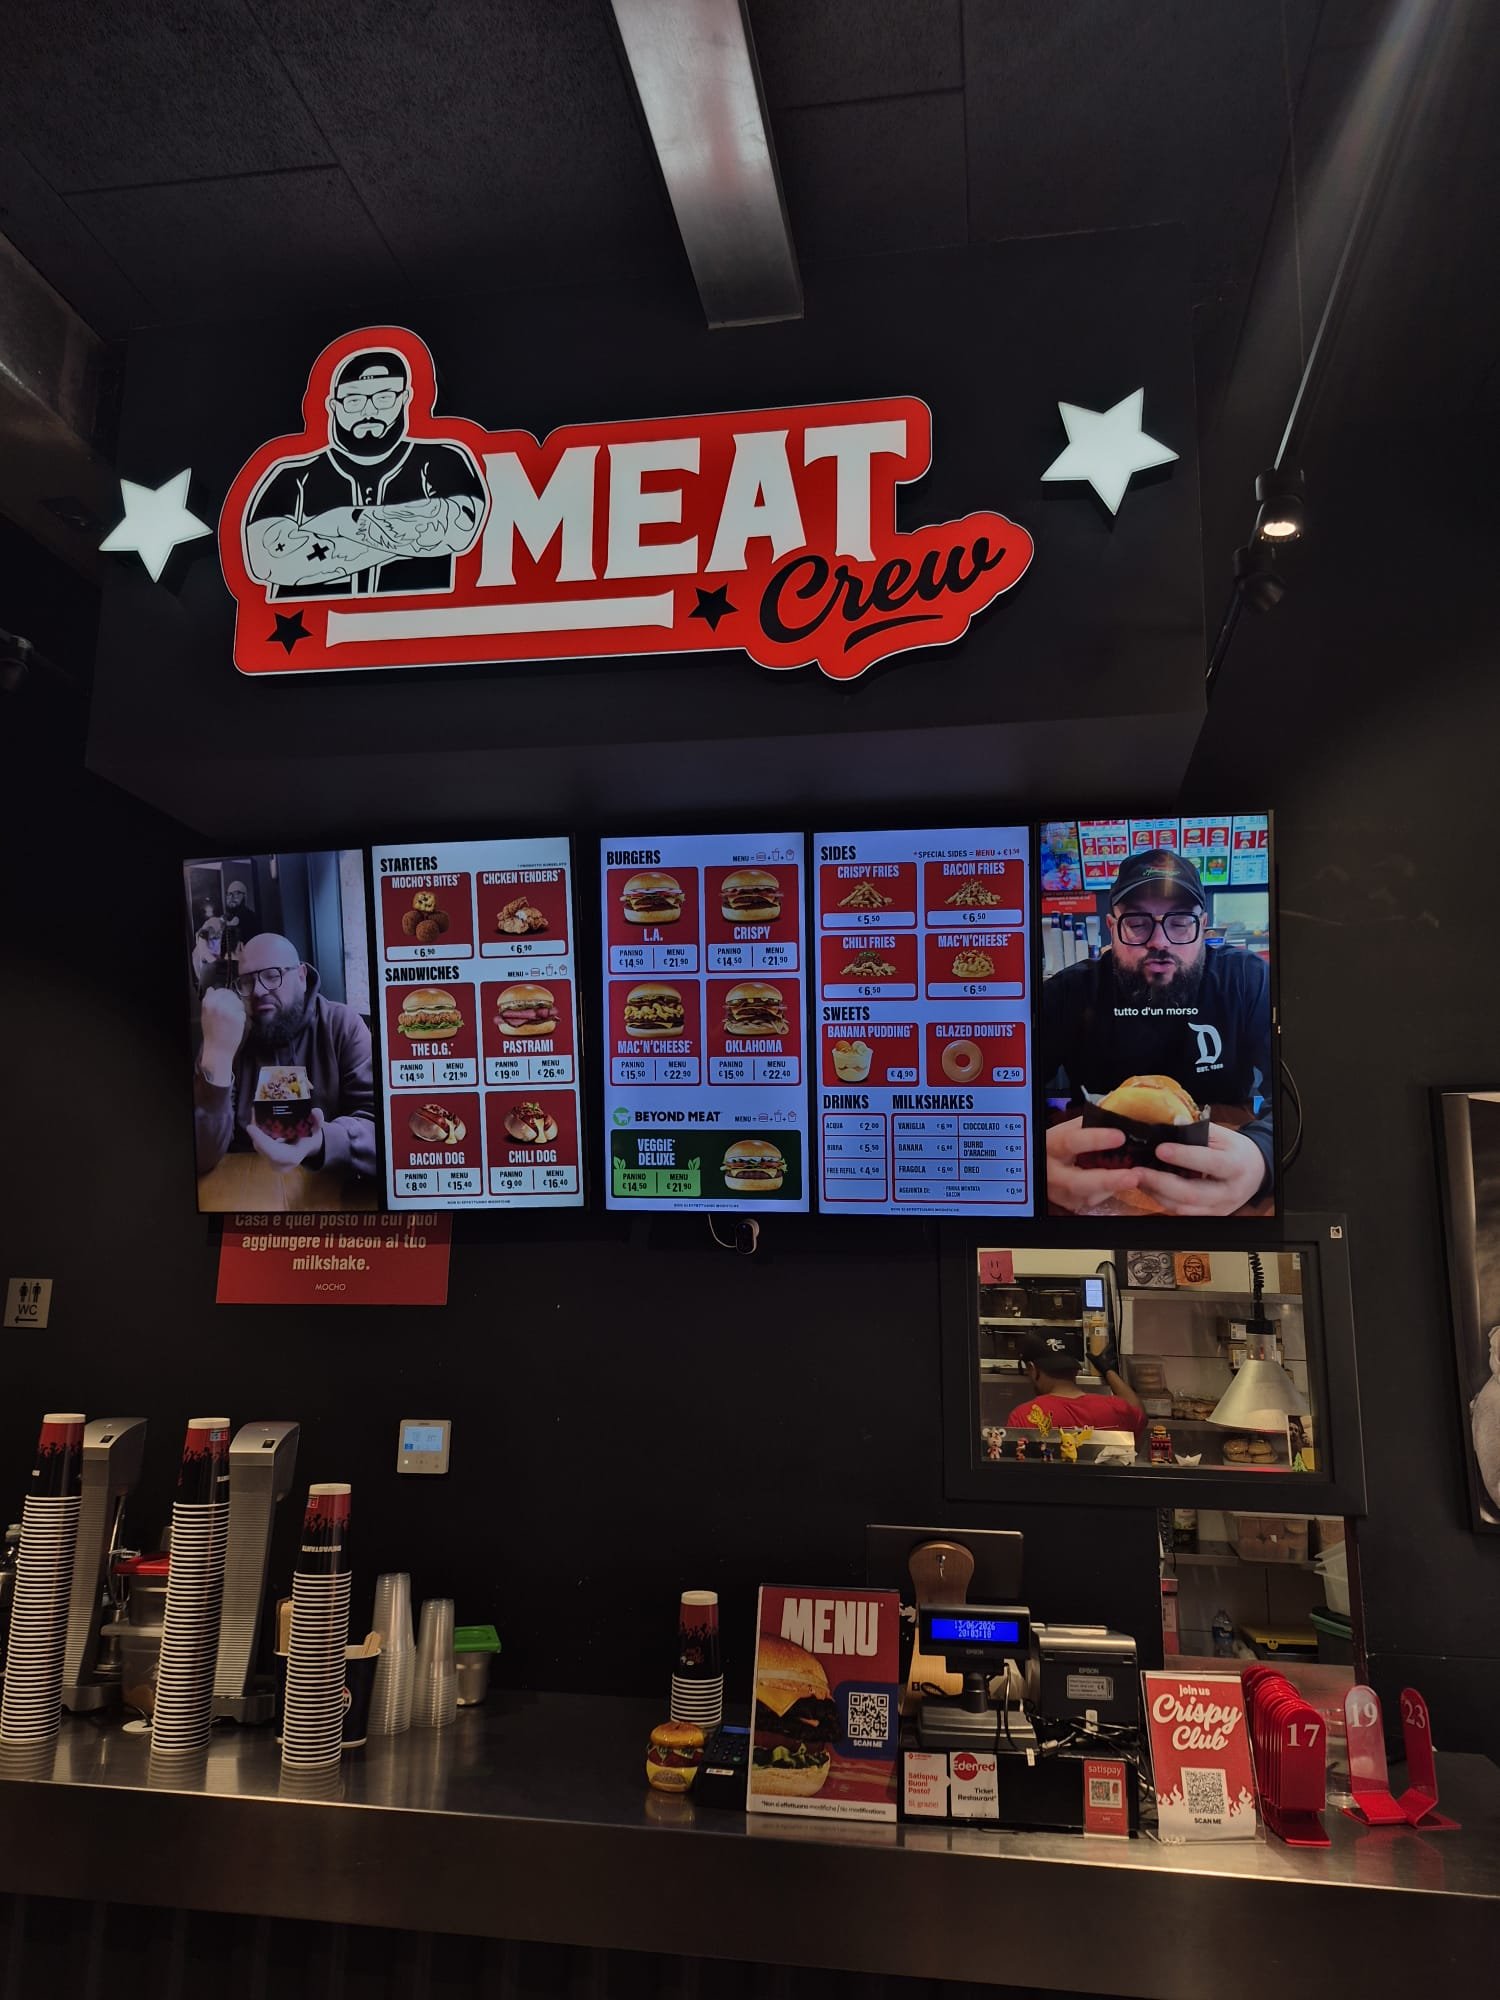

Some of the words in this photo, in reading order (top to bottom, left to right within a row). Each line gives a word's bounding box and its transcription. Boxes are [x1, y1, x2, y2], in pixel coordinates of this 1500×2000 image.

[476, 420, 906, 587] MEAT
[759, 536, 1006, 643] Crew
[607, 850, 661, 865] BURGERS
[821, 846, 856, 860] SIDES
[948, 850, 967, 858] SIDES
[975, 849, 995, 857] MENU
[380, 856, 437, 872] STARTERS
[943, 864, 975, 875] BACON
[978, 862, 1005, 874] FRIES
[838, 866, 870, 878] CRISPY
[872, 865, 899, 877] FRIES
[392, 876, 431, 888] MOCHO'S
[643, 928, 663, 941] L.A.
[734, 927, 770, 939] CRISPY
[843, 937, 867, 948] CHILI
[869, 936, 895, 948] FRIES
[385, 966, 459, 981] SANDWICHES
[823, 1006, 870, 1021] SWEETS
[1114, 1008, 1139, 1016] tutto
[1142, 1007, 1163, 1015] d'un
[828, 1026, 866, 1038] BANANA
[936, 1025, 972, 1037] GLAZED
[412, 1044, 429, 1056] THE
[503, 1040, 553, 1053] PASTRAMI
[725, 1040, 782, 1053] OKLAHOMA
[1188, 1023, 1222, 1064] D
[823, 1095, 869, 1109] DRINKS
[892, 1095, 973, 1109] MILKSHAKES
[635, 1112, 685, 1121] BEYOND
[688, 1111, 720, 1121] MEAT
[898, 1122, 926, 1130] VANIGLIA
[963, 1122, 1000, 1131] CIOCCOLATO
[898, 1144, 923, 1152] BANANA
[964, 1140, 984, 1148] BURRO
[410, 1153, 442, 1165] BACON
[445, 1152, 465, 1164] DOG
[509, 1151, 533, 1163] CHILI
[537, 1150, 557, 1162] DOG
[638, 1153, 675, 1165] DELUXE
[964, 1149, 997, 1157] D'ARACHIDI
[898, 1166, 926, 1174] FRAGOLA
[964, 1166, 980, 1174] OREO
[243, 1234, 320, 1250] aggiungere
[325, 1234, 334, 1248] il
[339, 1234, 380, 1248] bacon
[386, 1234, 399, 1248] al
[404, 1235, 426, 1248] tuo
[293, 1256, 370, 1270] milkshake.
[315, 1283, 346, 1291] MOCHO
[18, 1304, 38, 1315] WC
[1199, 1687, 1210, 1696] us
[1153, 1694, 1243, 1734] Crispy
[1351, 1703, 1378, 1727] 19
[1404, 1700, 1426, 1729] 23
[1172, 1725, 1228, 1750] Club
[1287, 1723, 1320, 1747] 17
[873, 1740, 882, 1748] ME
[954, 1761, 995, 1771] Edenred
[1088, 1765, 1122, 1776] satispay
